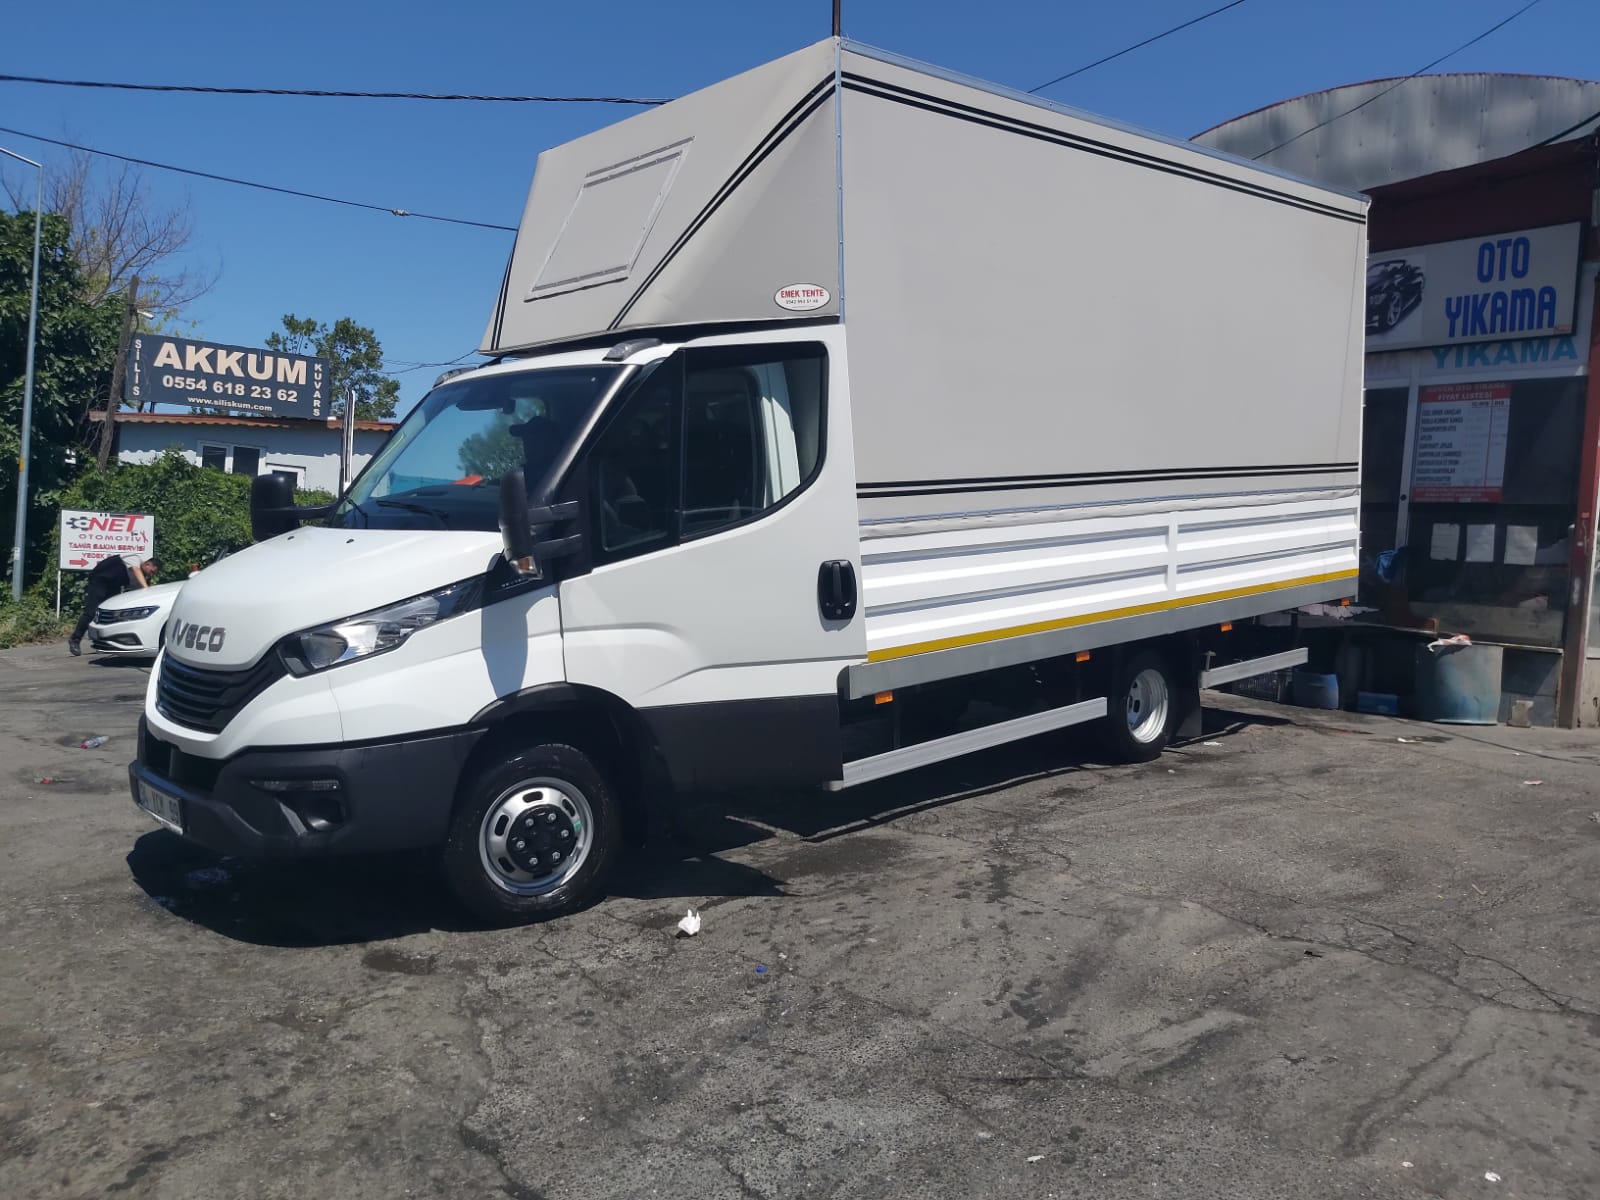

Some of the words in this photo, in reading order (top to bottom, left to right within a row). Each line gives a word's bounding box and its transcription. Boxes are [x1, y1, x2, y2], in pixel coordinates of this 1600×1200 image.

[1476, 236, 1530, 283] OTO
[780, 289, 800, 299] EMEK
[801, 288, 825, 298] TENTE
[1445, 286, 1557, 338] YIKAMA
[153, 341, 307, 385] AKKUM
[1432, 335, 1578, 369] YIKAMA
[162, 374, 207, 392] 0554
[212, 381, 245, 396] 618
[250, 386, 272, 399] 23
[276, 389, 298, 403] 62
[187, 396, 273, 412] www.siliskum.com
[313, 363, 323, 417] KUVARS
[172, 618, 226, 653] IVECO
